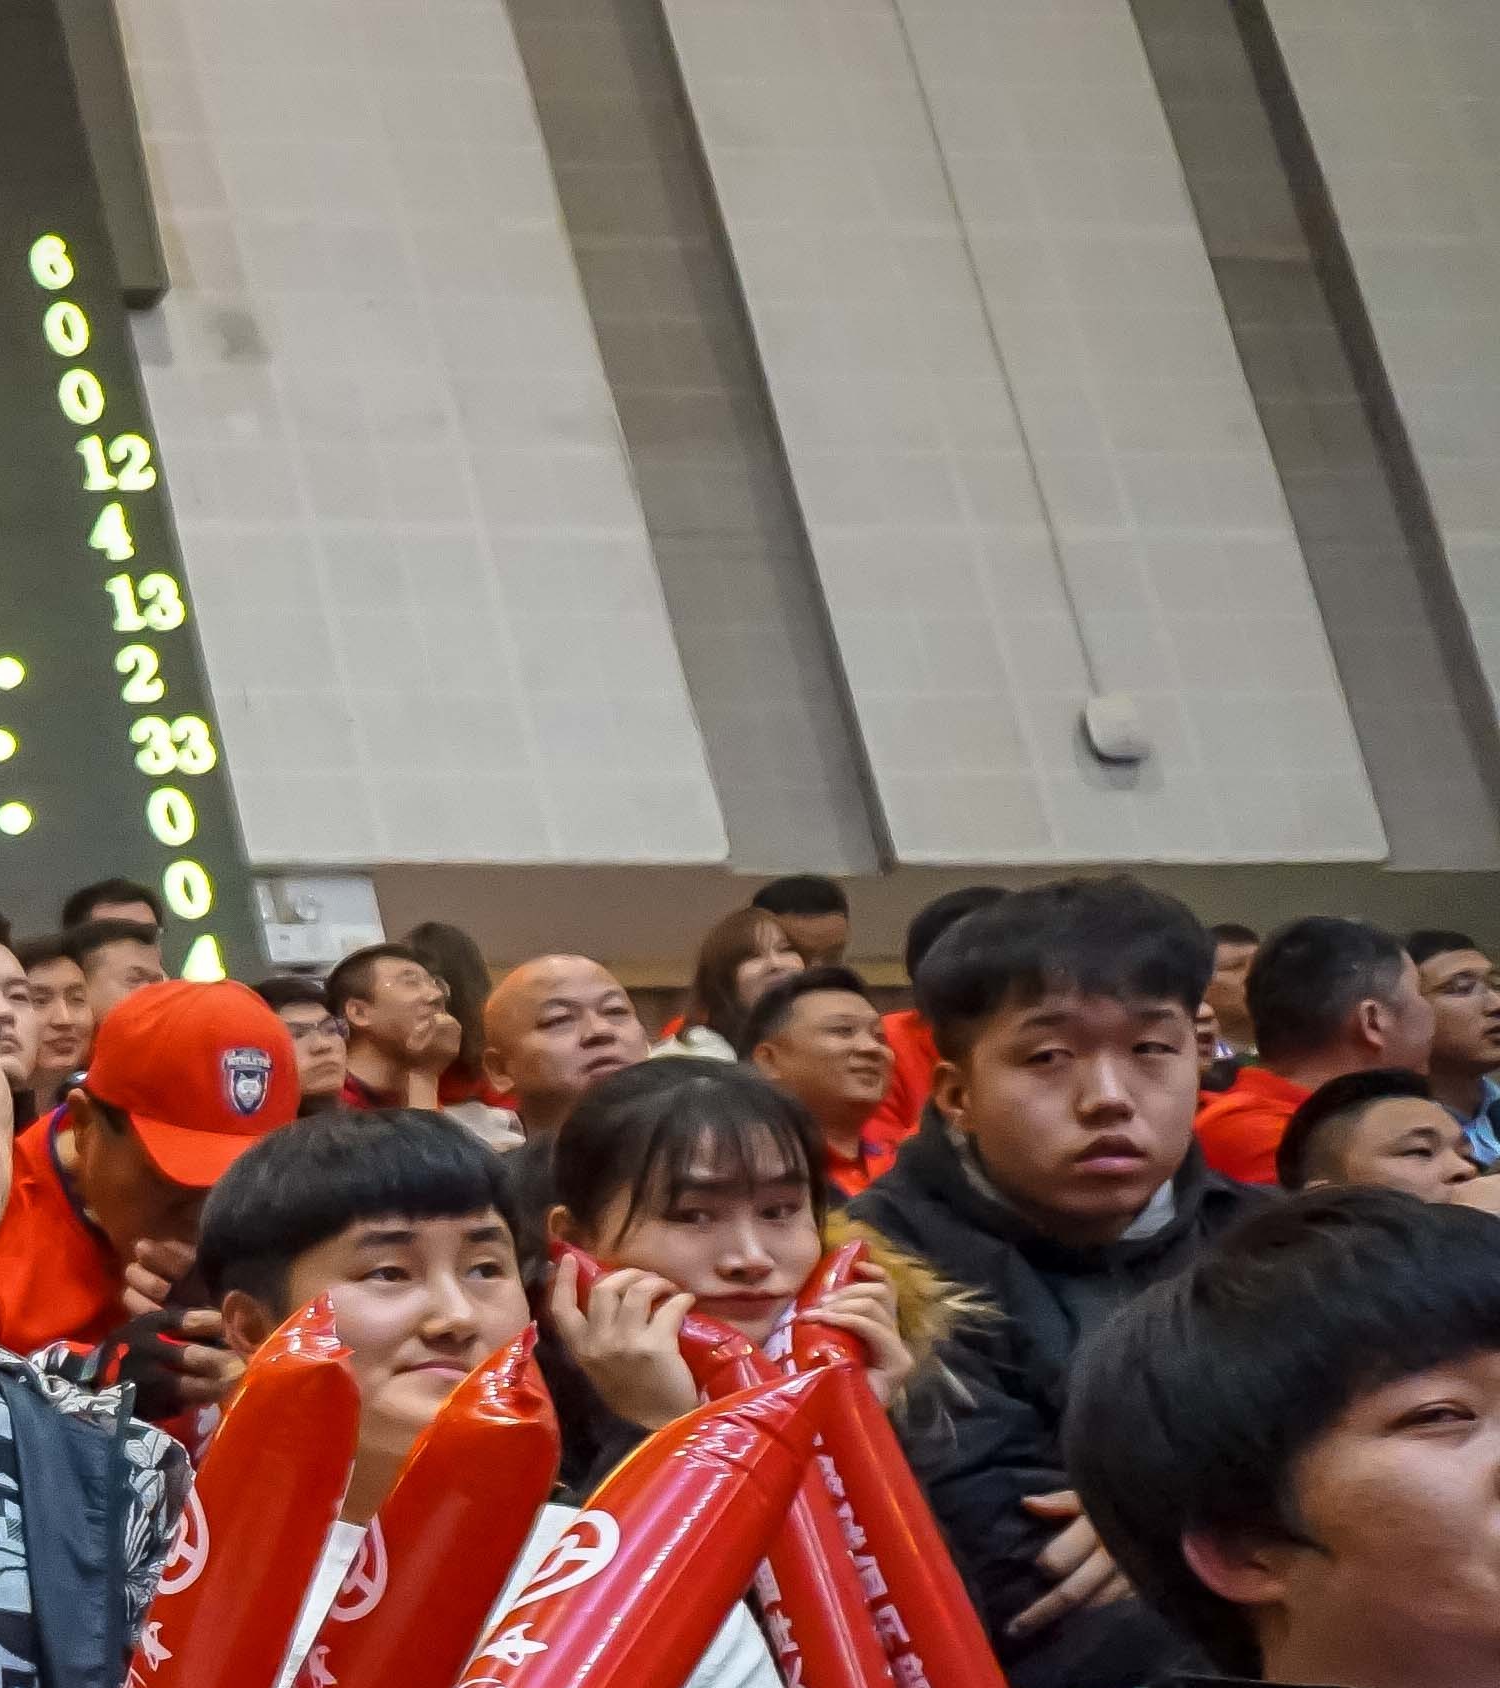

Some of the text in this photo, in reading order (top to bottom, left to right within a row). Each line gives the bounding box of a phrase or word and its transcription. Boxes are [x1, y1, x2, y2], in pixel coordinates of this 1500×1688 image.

[31, 235, 73, 289] 6
[45, 302, 89, 356] 0
[59, 369, 104, 424] 0
[78, 430, 156, 490] 12
[91, 503, 134, 560] 4
[106, 568, 186, 631] 13
[117, 645, 164, 702] 2
[132, 712, 218, 774] 33
[148, 788, 194, 845] 0
[165, 861, 212, 919] 0
